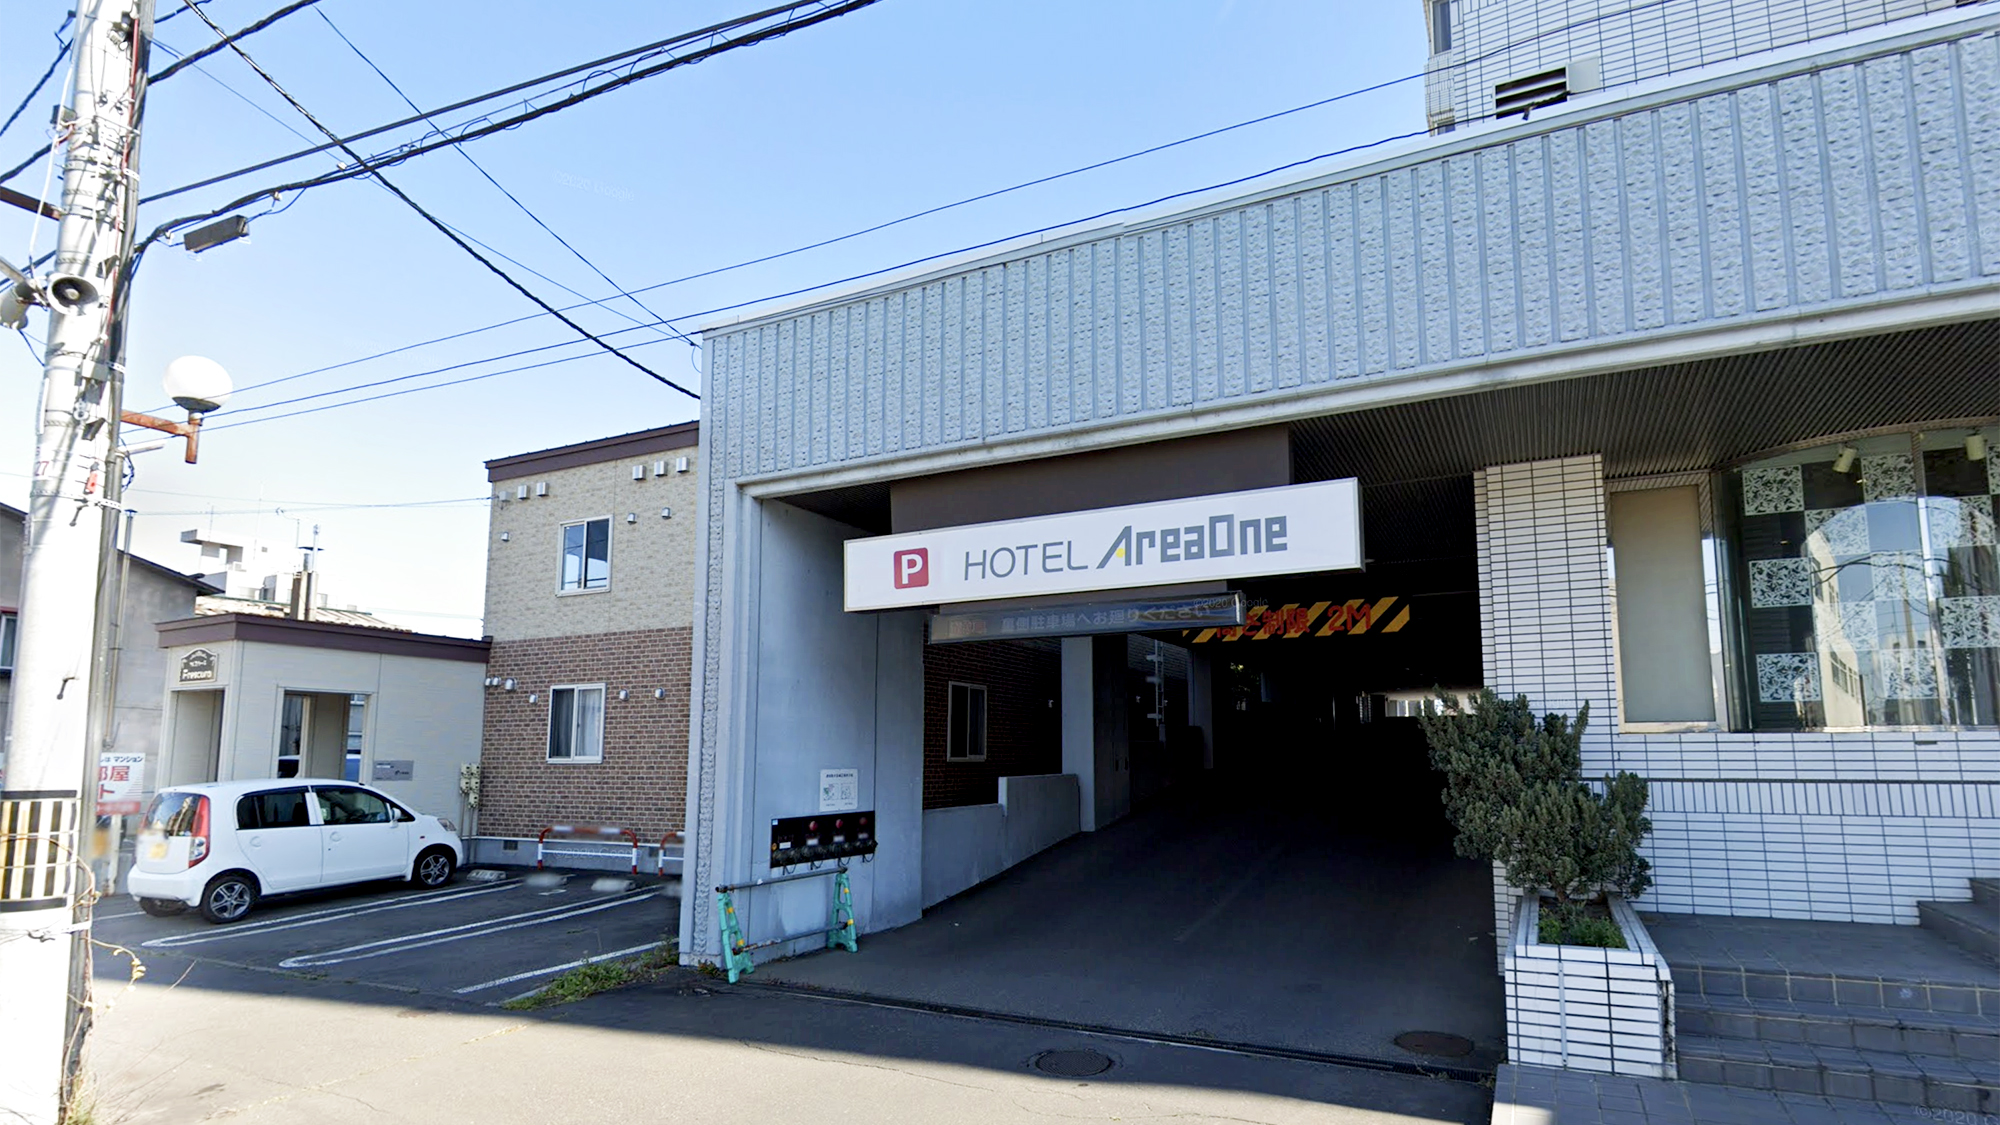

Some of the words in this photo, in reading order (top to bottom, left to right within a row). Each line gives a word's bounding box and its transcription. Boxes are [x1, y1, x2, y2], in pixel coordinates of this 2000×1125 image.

[901, 553, 923, 584] P
[964, 540, 1088, 580] HOTEL
[1096, 514, 1288, 569] AreaOne
[1327, 604, 1371, 632] 2M
[113, 755, 144, 763] マンション
